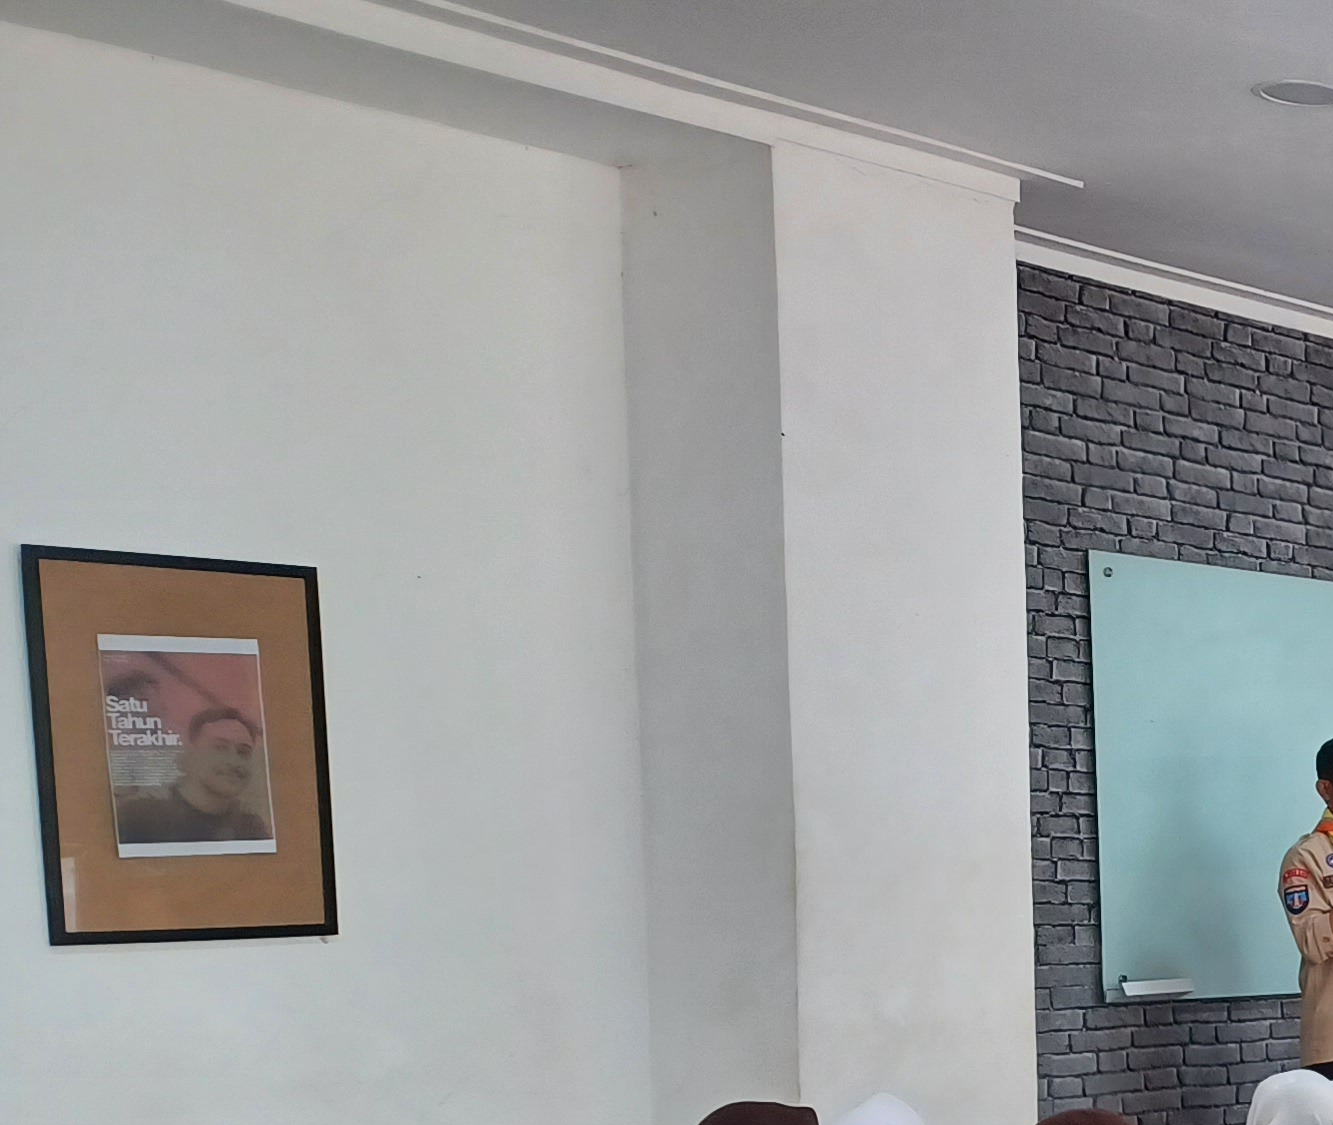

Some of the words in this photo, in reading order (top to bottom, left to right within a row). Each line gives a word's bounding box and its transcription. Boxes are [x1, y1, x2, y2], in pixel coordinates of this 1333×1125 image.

[106, 695, 148, 713] Satu
[107, 712, 162, 729] Tahun
[108, 729, 183, 746] Terakhir.
